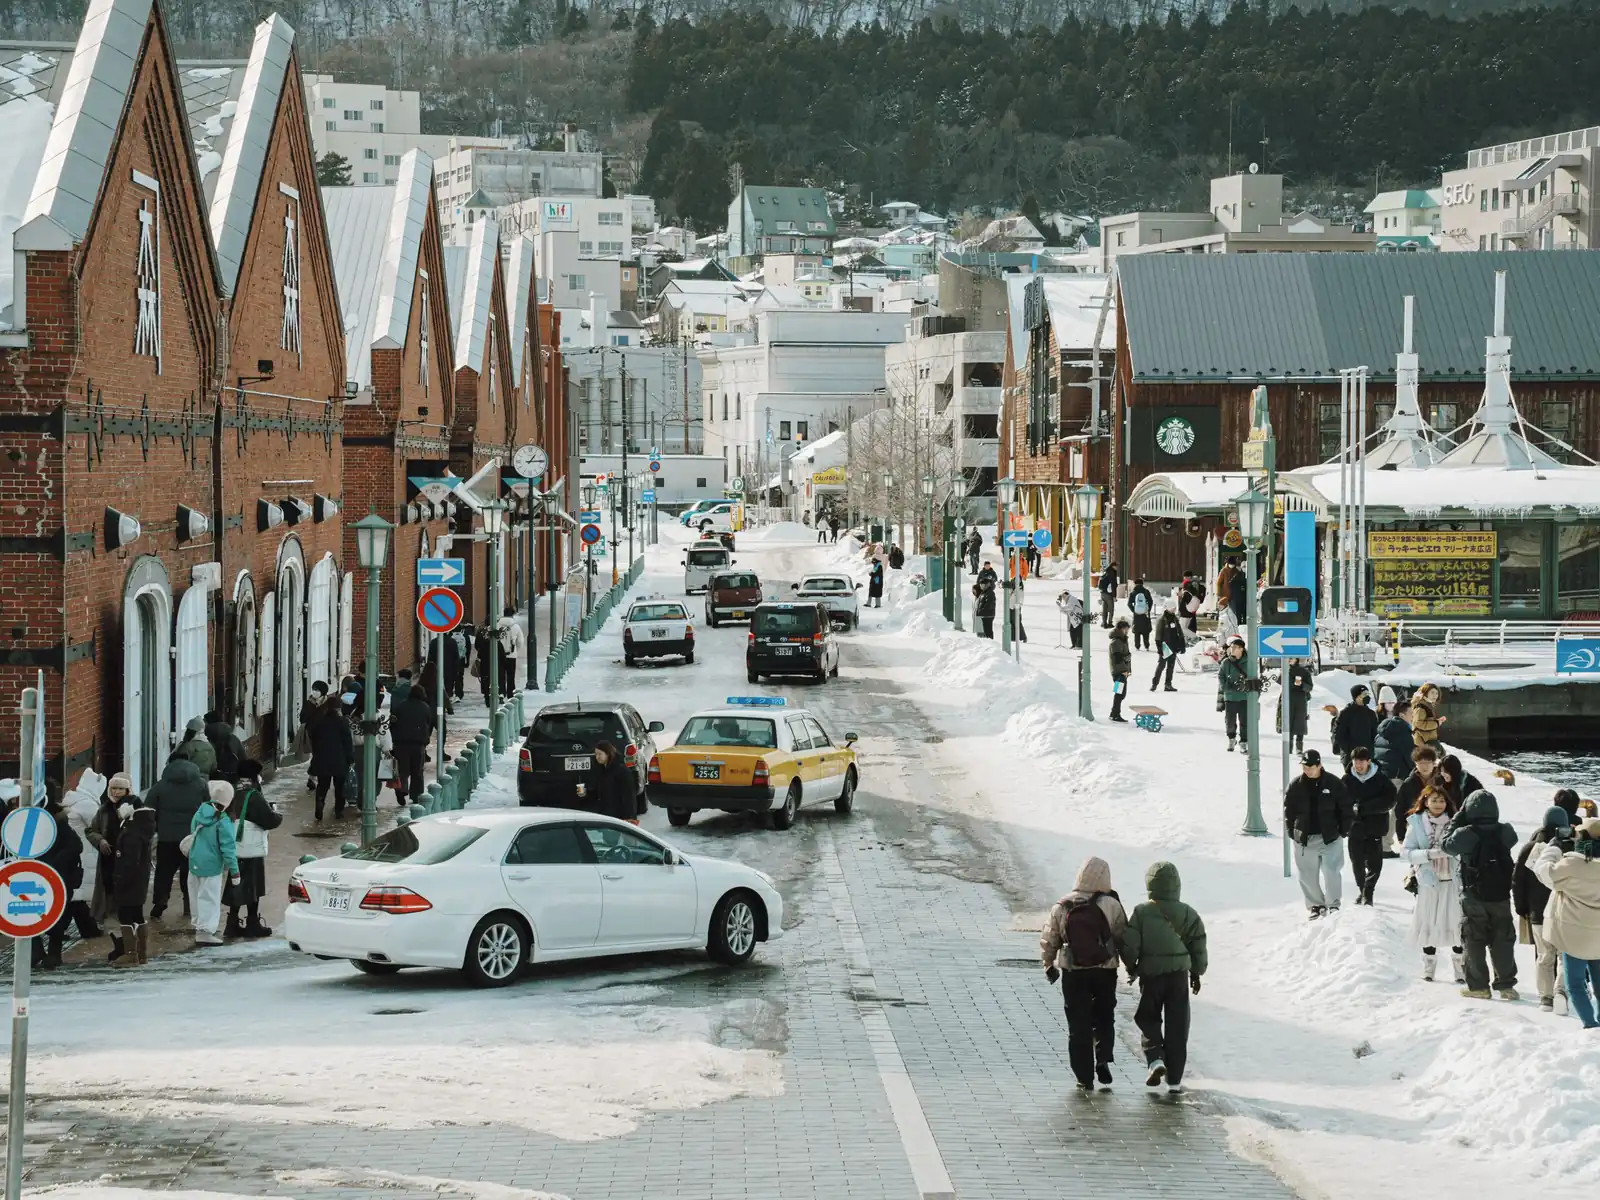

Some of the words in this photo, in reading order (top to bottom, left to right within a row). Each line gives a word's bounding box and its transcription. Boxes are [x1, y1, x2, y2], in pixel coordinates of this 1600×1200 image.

[1443, 181, 1475, 206] SEC
[549, 203, 566, 216] hif
[699, 770, 719, 778] 25-65
[328, 897, 348, 909] 88-15
